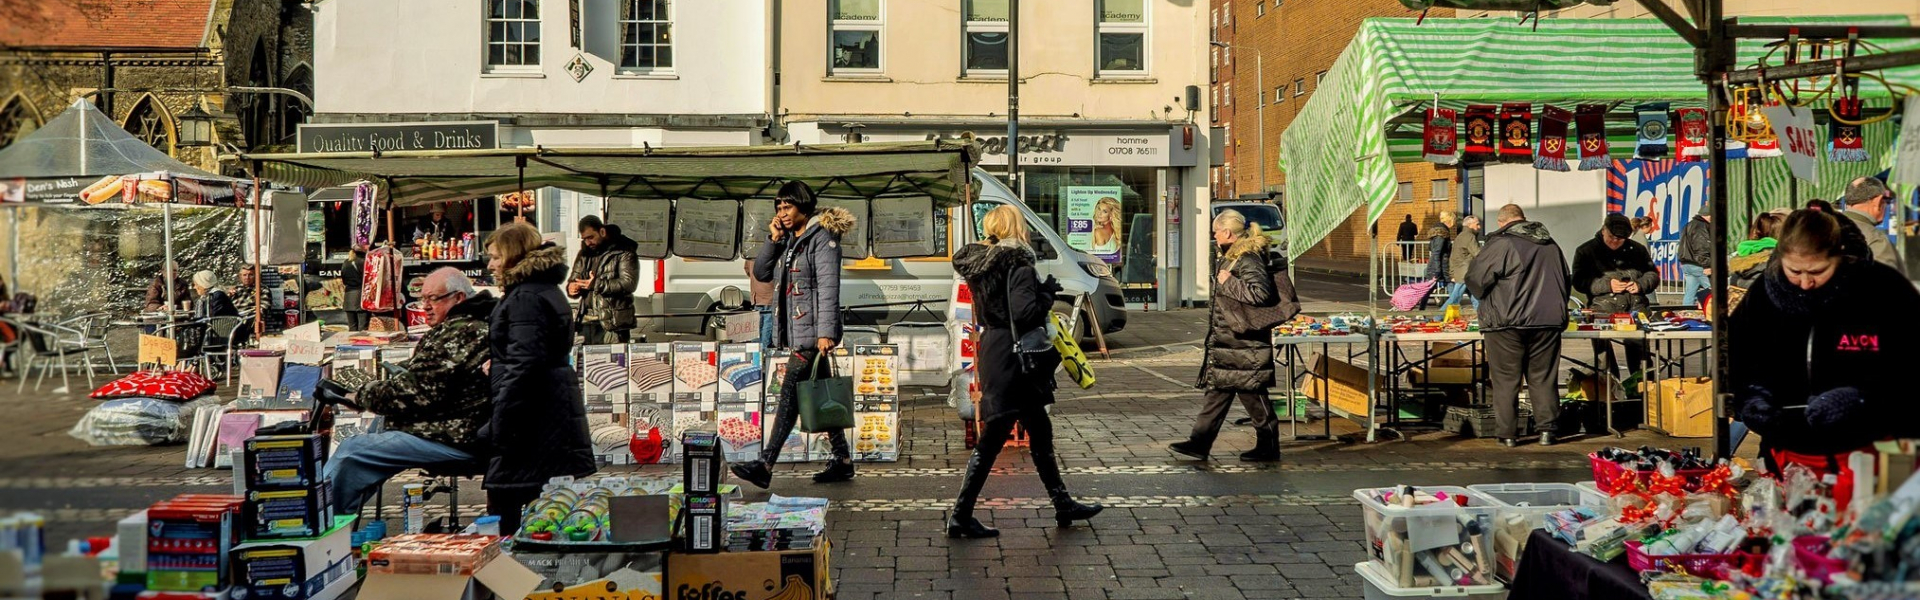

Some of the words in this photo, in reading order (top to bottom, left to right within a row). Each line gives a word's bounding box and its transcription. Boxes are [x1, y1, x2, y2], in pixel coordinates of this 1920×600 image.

[1101, 12, 1141, 20] academy
[312, 132, 365, 153] Quality
[370, 130, 405, 151] Food
[413, 130, 424, 149] &
[434, 128, 482, 149] Drinks
[1785, 125, 1816, 157] SALE
[1108, 147, 1133, 155] 01708
[1136, 147, 1158, 155] 765111
[1033, 155, 1062, 163] group
[27, 182, 54, 192] Den's
[1073, 220, 1088, 229] £85
[781, 555, 813, 564] Bananas
